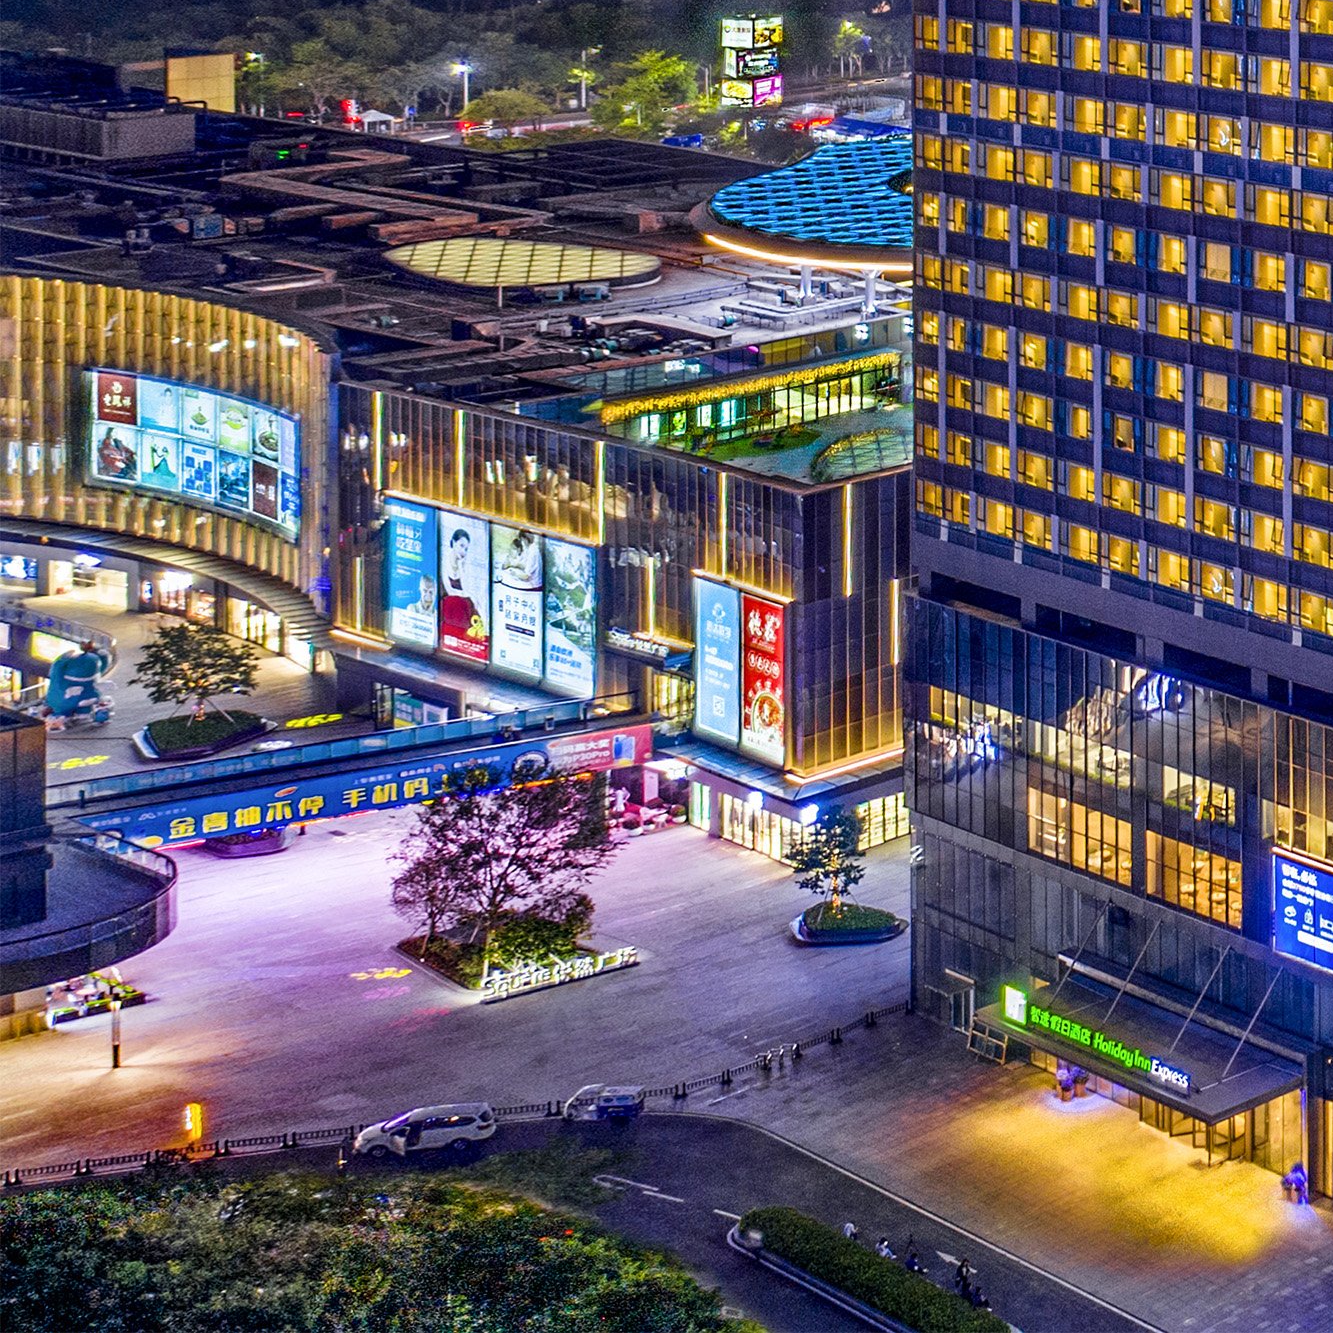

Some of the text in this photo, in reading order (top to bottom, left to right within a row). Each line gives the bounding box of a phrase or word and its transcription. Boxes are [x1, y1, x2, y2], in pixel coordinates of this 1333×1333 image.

[1030, 1005, 1091, 1047] 智选假日酒店
[1093, 1032, 1134, 1068] Holiday
[1151, 1059, 1189, 1089] Express
